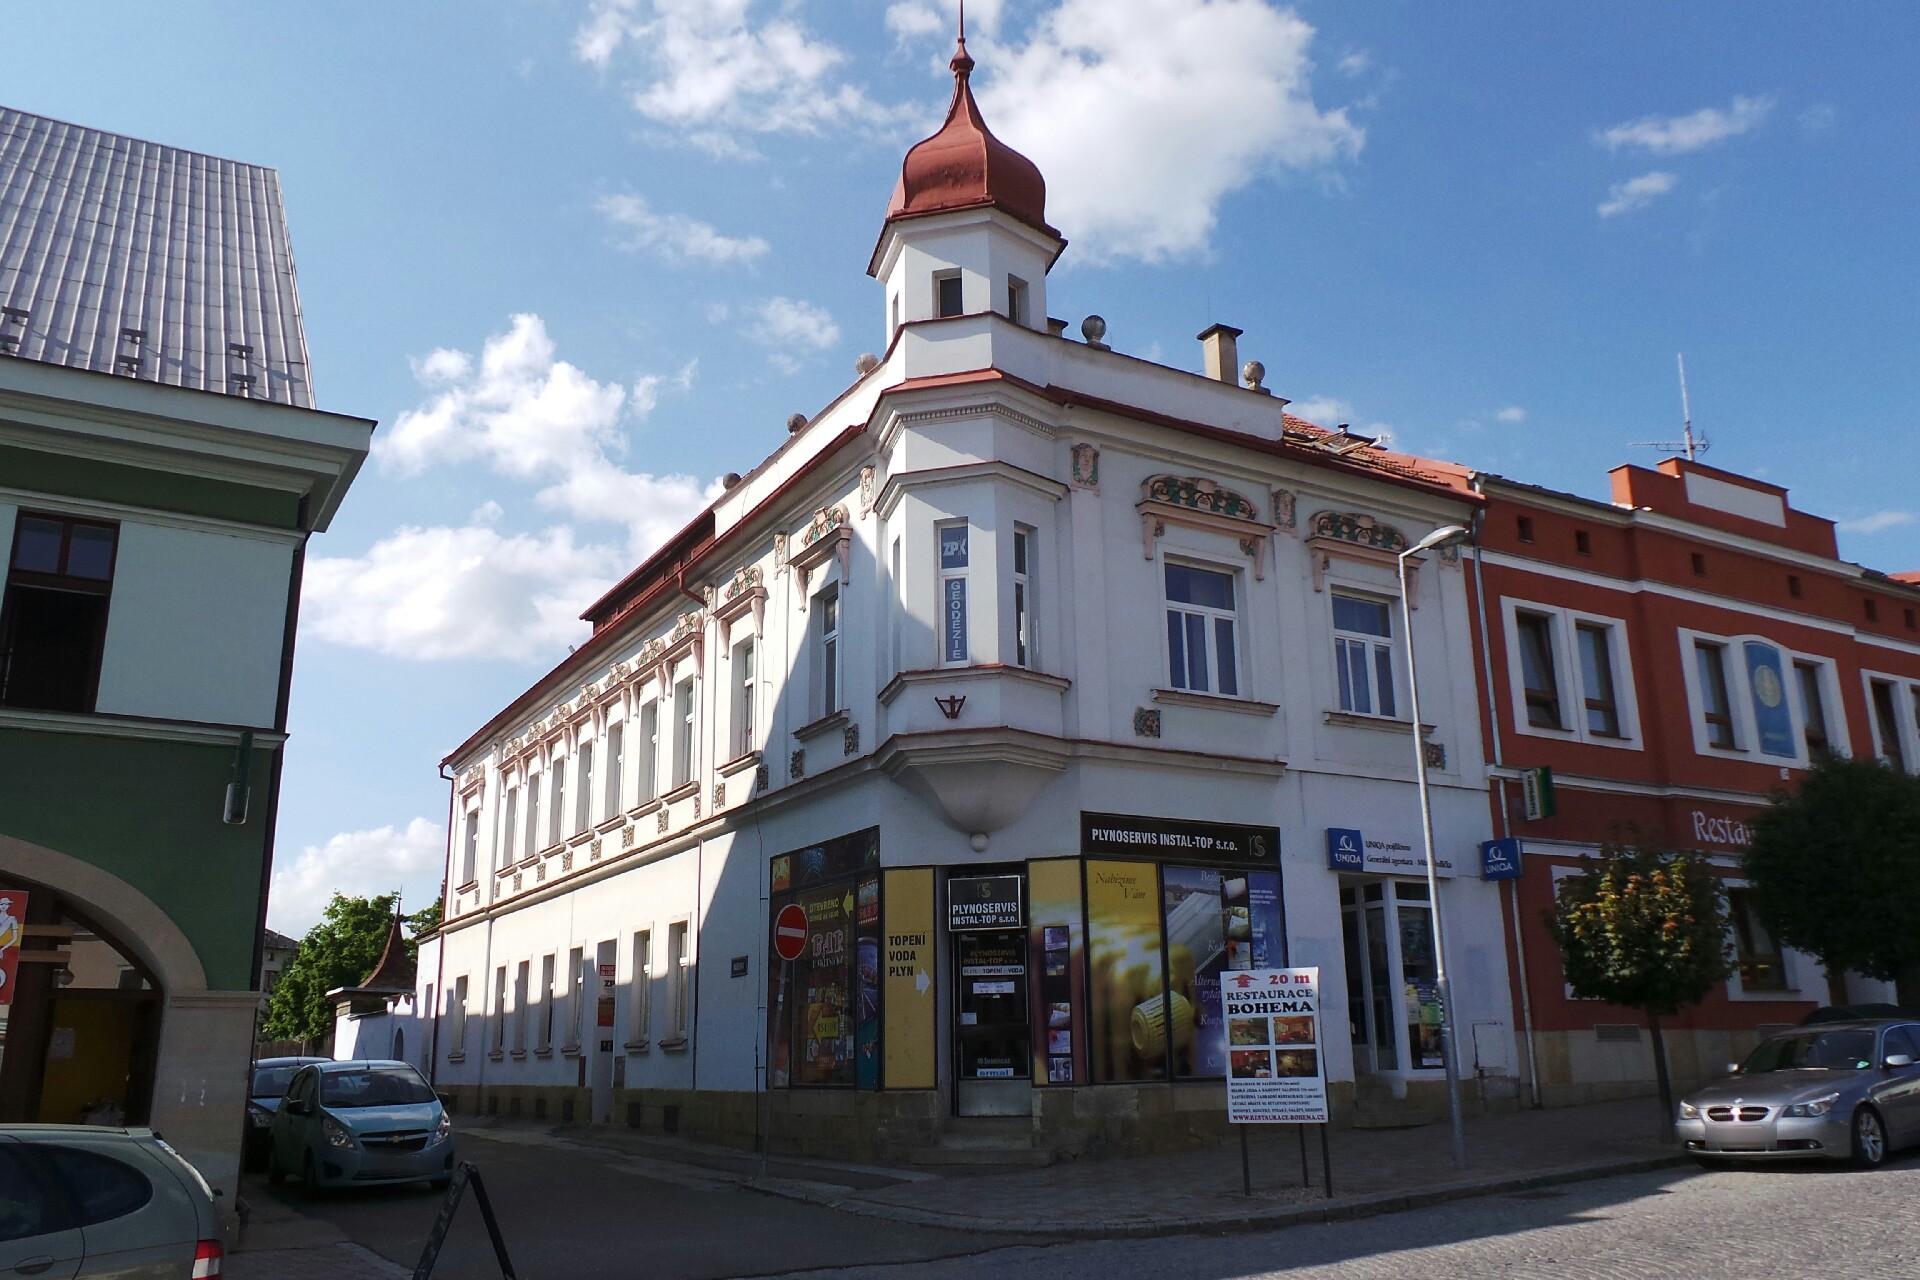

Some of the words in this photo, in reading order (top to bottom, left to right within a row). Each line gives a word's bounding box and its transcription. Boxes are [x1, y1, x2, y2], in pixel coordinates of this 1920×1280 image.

[951, 580, 962, 659] GEODEZIE
[1691, 810, 1752, 845] Resta
[1092, 828, 1157, 845] PLYNOSERVIS
[1160, 833, 1214, 849] INSTAL-TOP
[1216, 840, 1238, 851] s.r.o.
[1365, 840, 1386, 850] UNIQA
[1335, 853, 1362, 864] UNIQA
[1486, 863, 1513, 874] UNIQA
[952, 901, 1018, 915] PLYNOSERVIS
[953, 914, 997, 925] INSTAL-TOP
[889, 932, 926, 946] TOPENÍ
[889, 950, 916, 962] VODA
[889, 966, 914, 977] PLYN
[1269, 974, 1289, 985] 20
[1294, 974, 1311, 984] m
[1226, 988, 1314, 1001] RESTAURACE
[1228, 1000, 1315, 1015] BOHEMA
